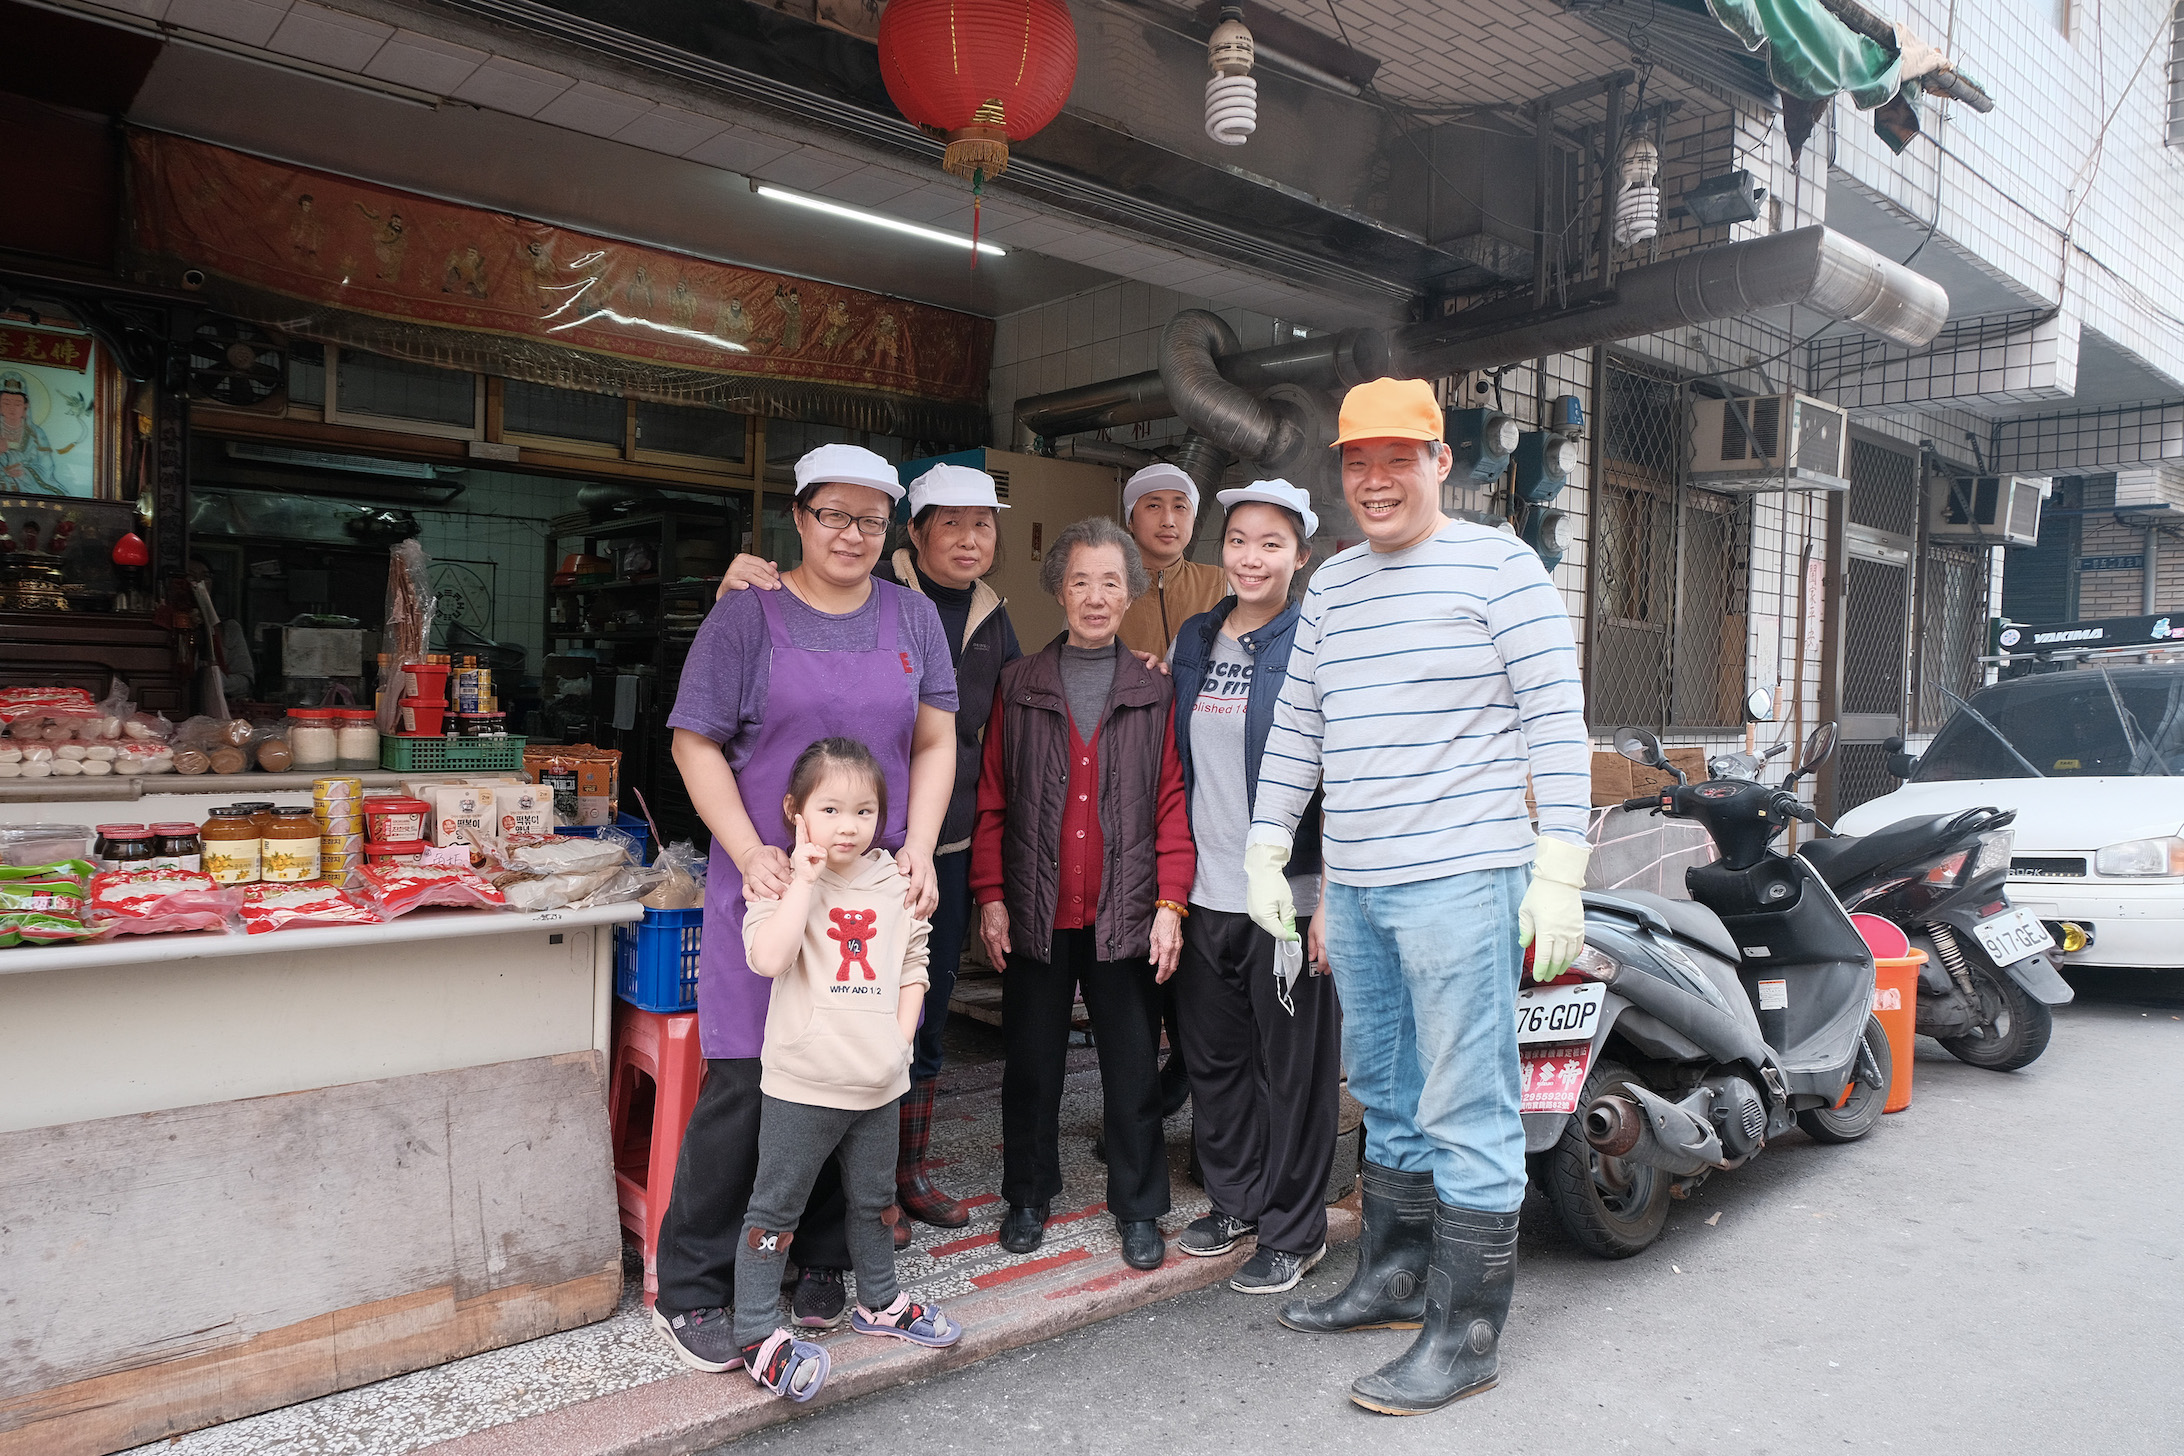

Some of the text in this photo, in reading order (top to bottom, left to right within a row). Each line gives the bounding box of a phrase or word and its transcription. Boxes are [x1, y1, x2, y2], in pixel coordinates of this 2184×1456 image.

[2034, 628, 2103, 644] YAKIMA
[830, 985, 882, 995] WHY AND 1/2
